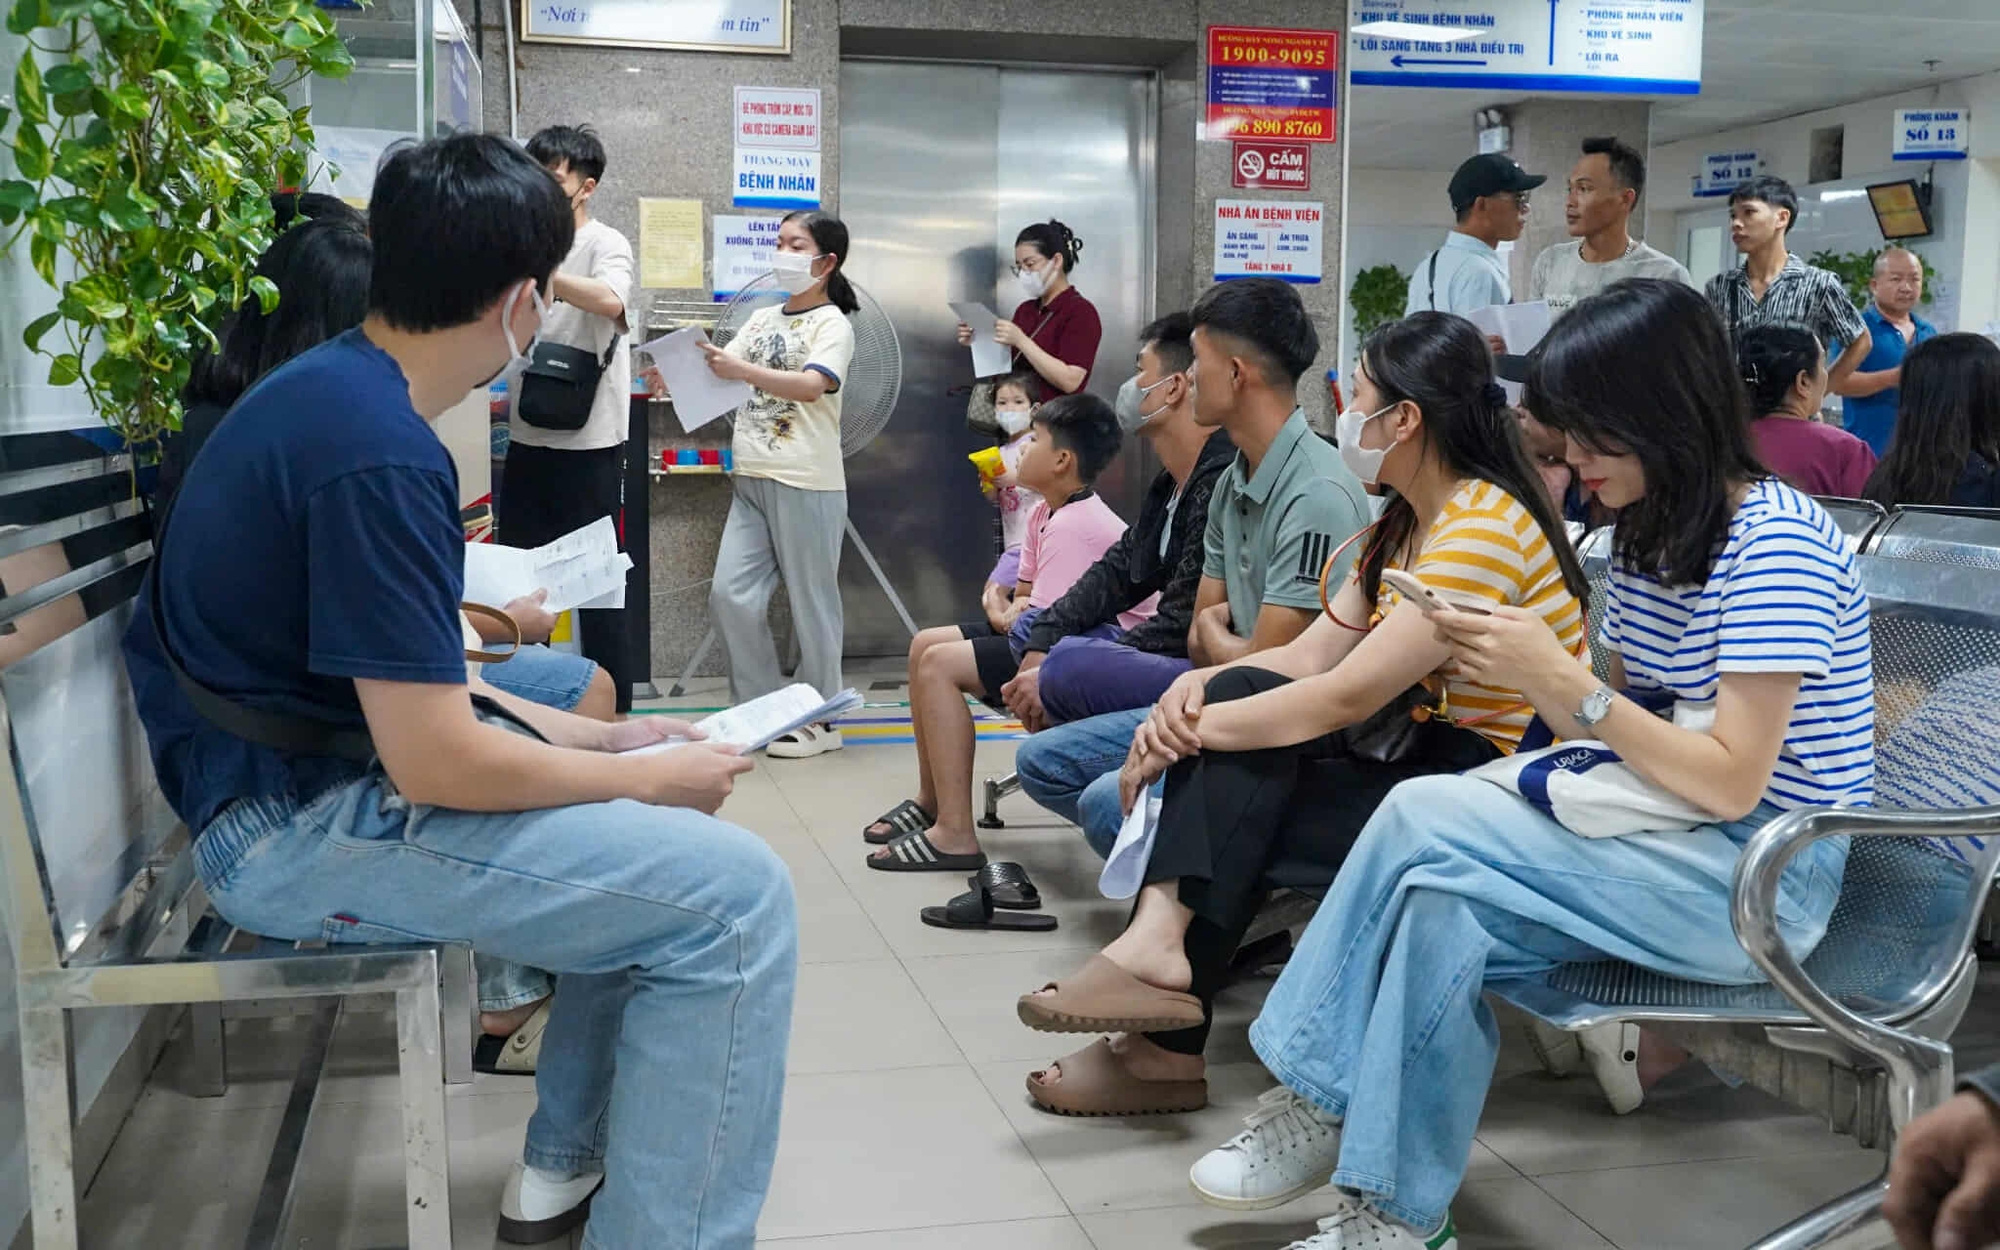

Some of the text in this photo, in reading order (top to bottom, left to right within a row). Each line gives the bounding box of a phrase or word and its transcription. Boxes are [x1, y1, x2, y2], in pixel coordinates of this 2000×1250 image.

[1404, 12, 1429, 24] SINH
[1626, 31, 1652, 40] SINH
[1381, 40, 1411, 52] SANG
[1445, 42, 1452, 52] 3
[1223, 46, 1325, 65] 1900-9095
[1605, 53, 1619, 62] RA
[1253, 119, 1281, 135] 890
[1285, 120, 1323, 136] 8760
[1906, 123, 1956, 141] SỐ 13
[742, 154, 783, 165] THANG
[1269, 148, 1303, 166] CẤM
[739, 170, 815, 192] BỆNH NHÂN
[1218, 204, 1241, 219] NHÀ
[1263, 205, 1292, 222] BỆNH
[1295, 207, 1320, 223] VIỆN
